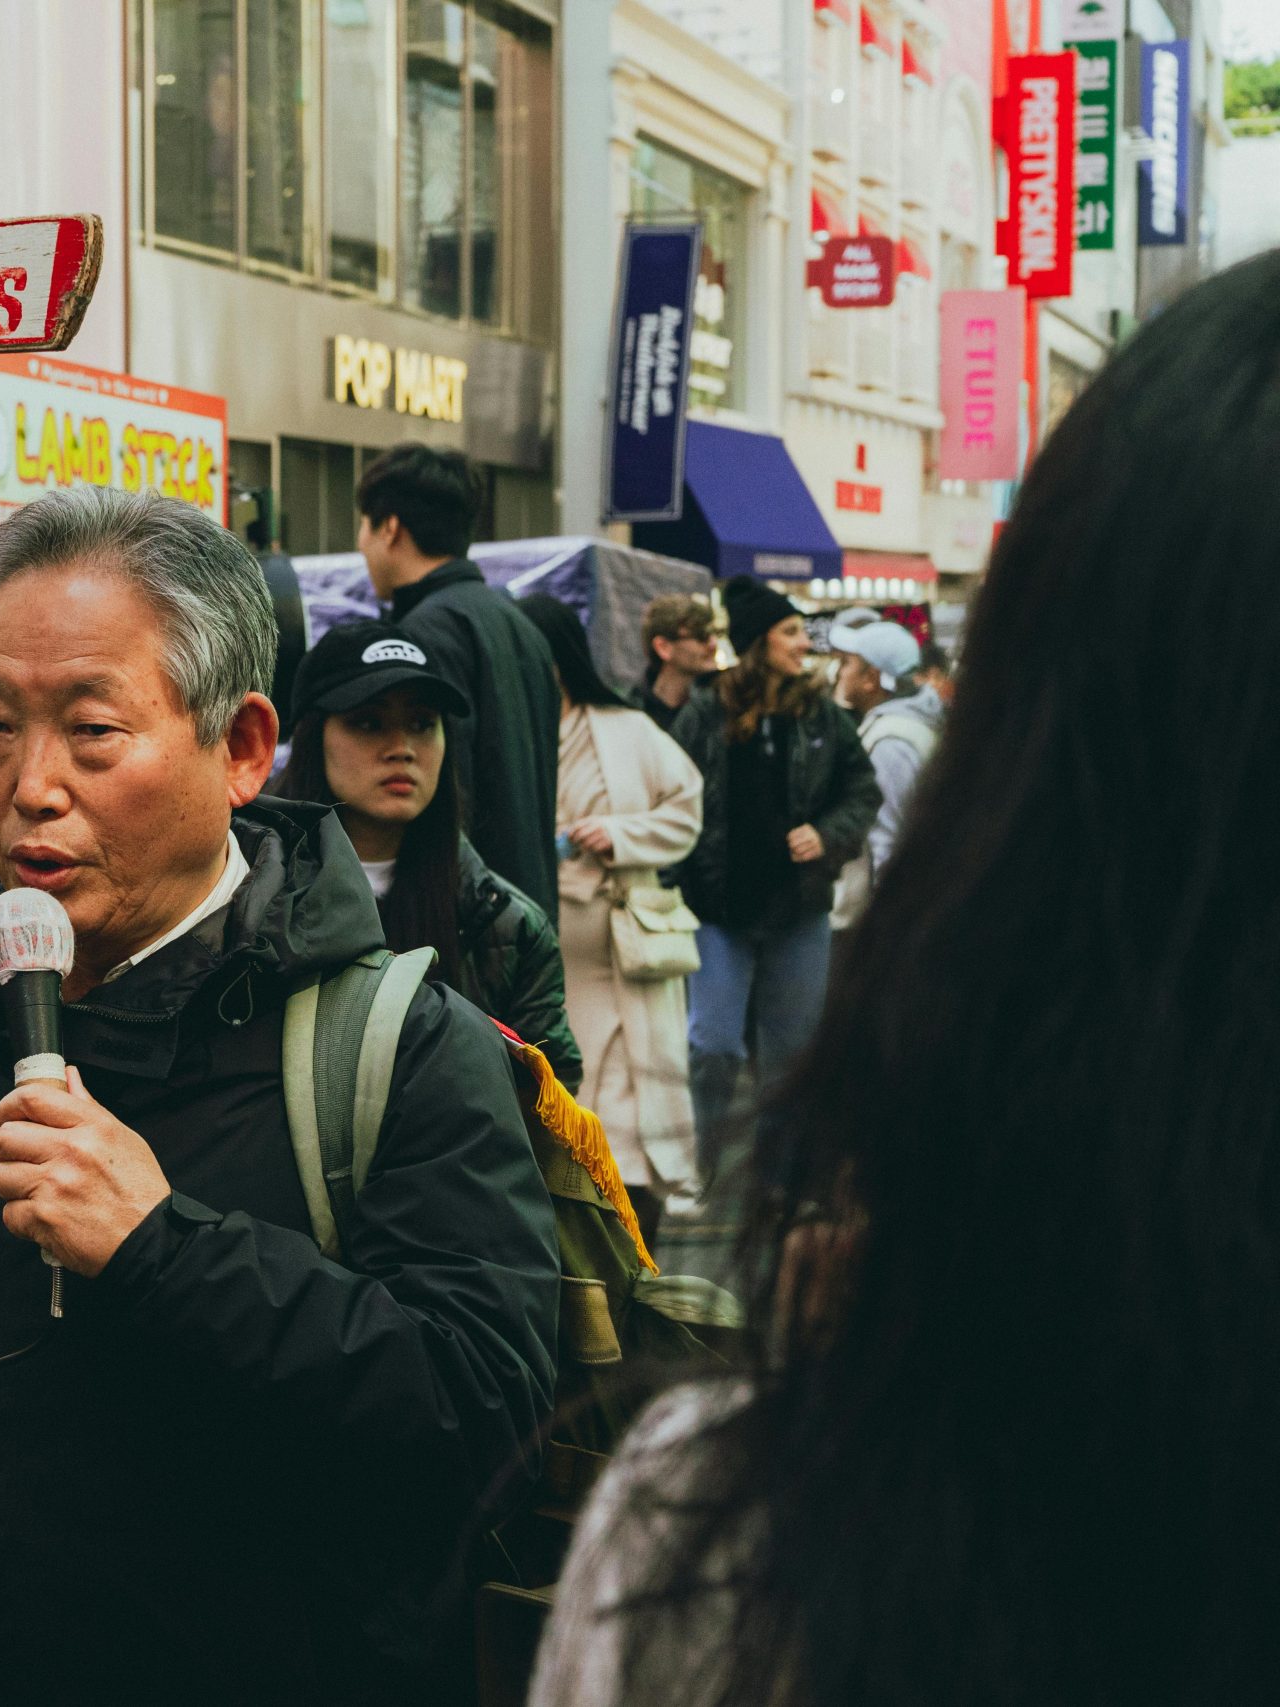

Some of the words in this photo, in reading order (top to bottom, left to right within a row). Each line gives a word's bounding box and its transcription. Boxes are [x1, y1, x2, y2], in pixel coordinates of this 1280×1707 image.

[335, 333, 392, 410] POP
[395, 346, 467, 423] MART
[964, 319, 998, 449] ETUDE
[15, 402, 112, 487] LAMB
[123, 423, 215, 508] STICK
